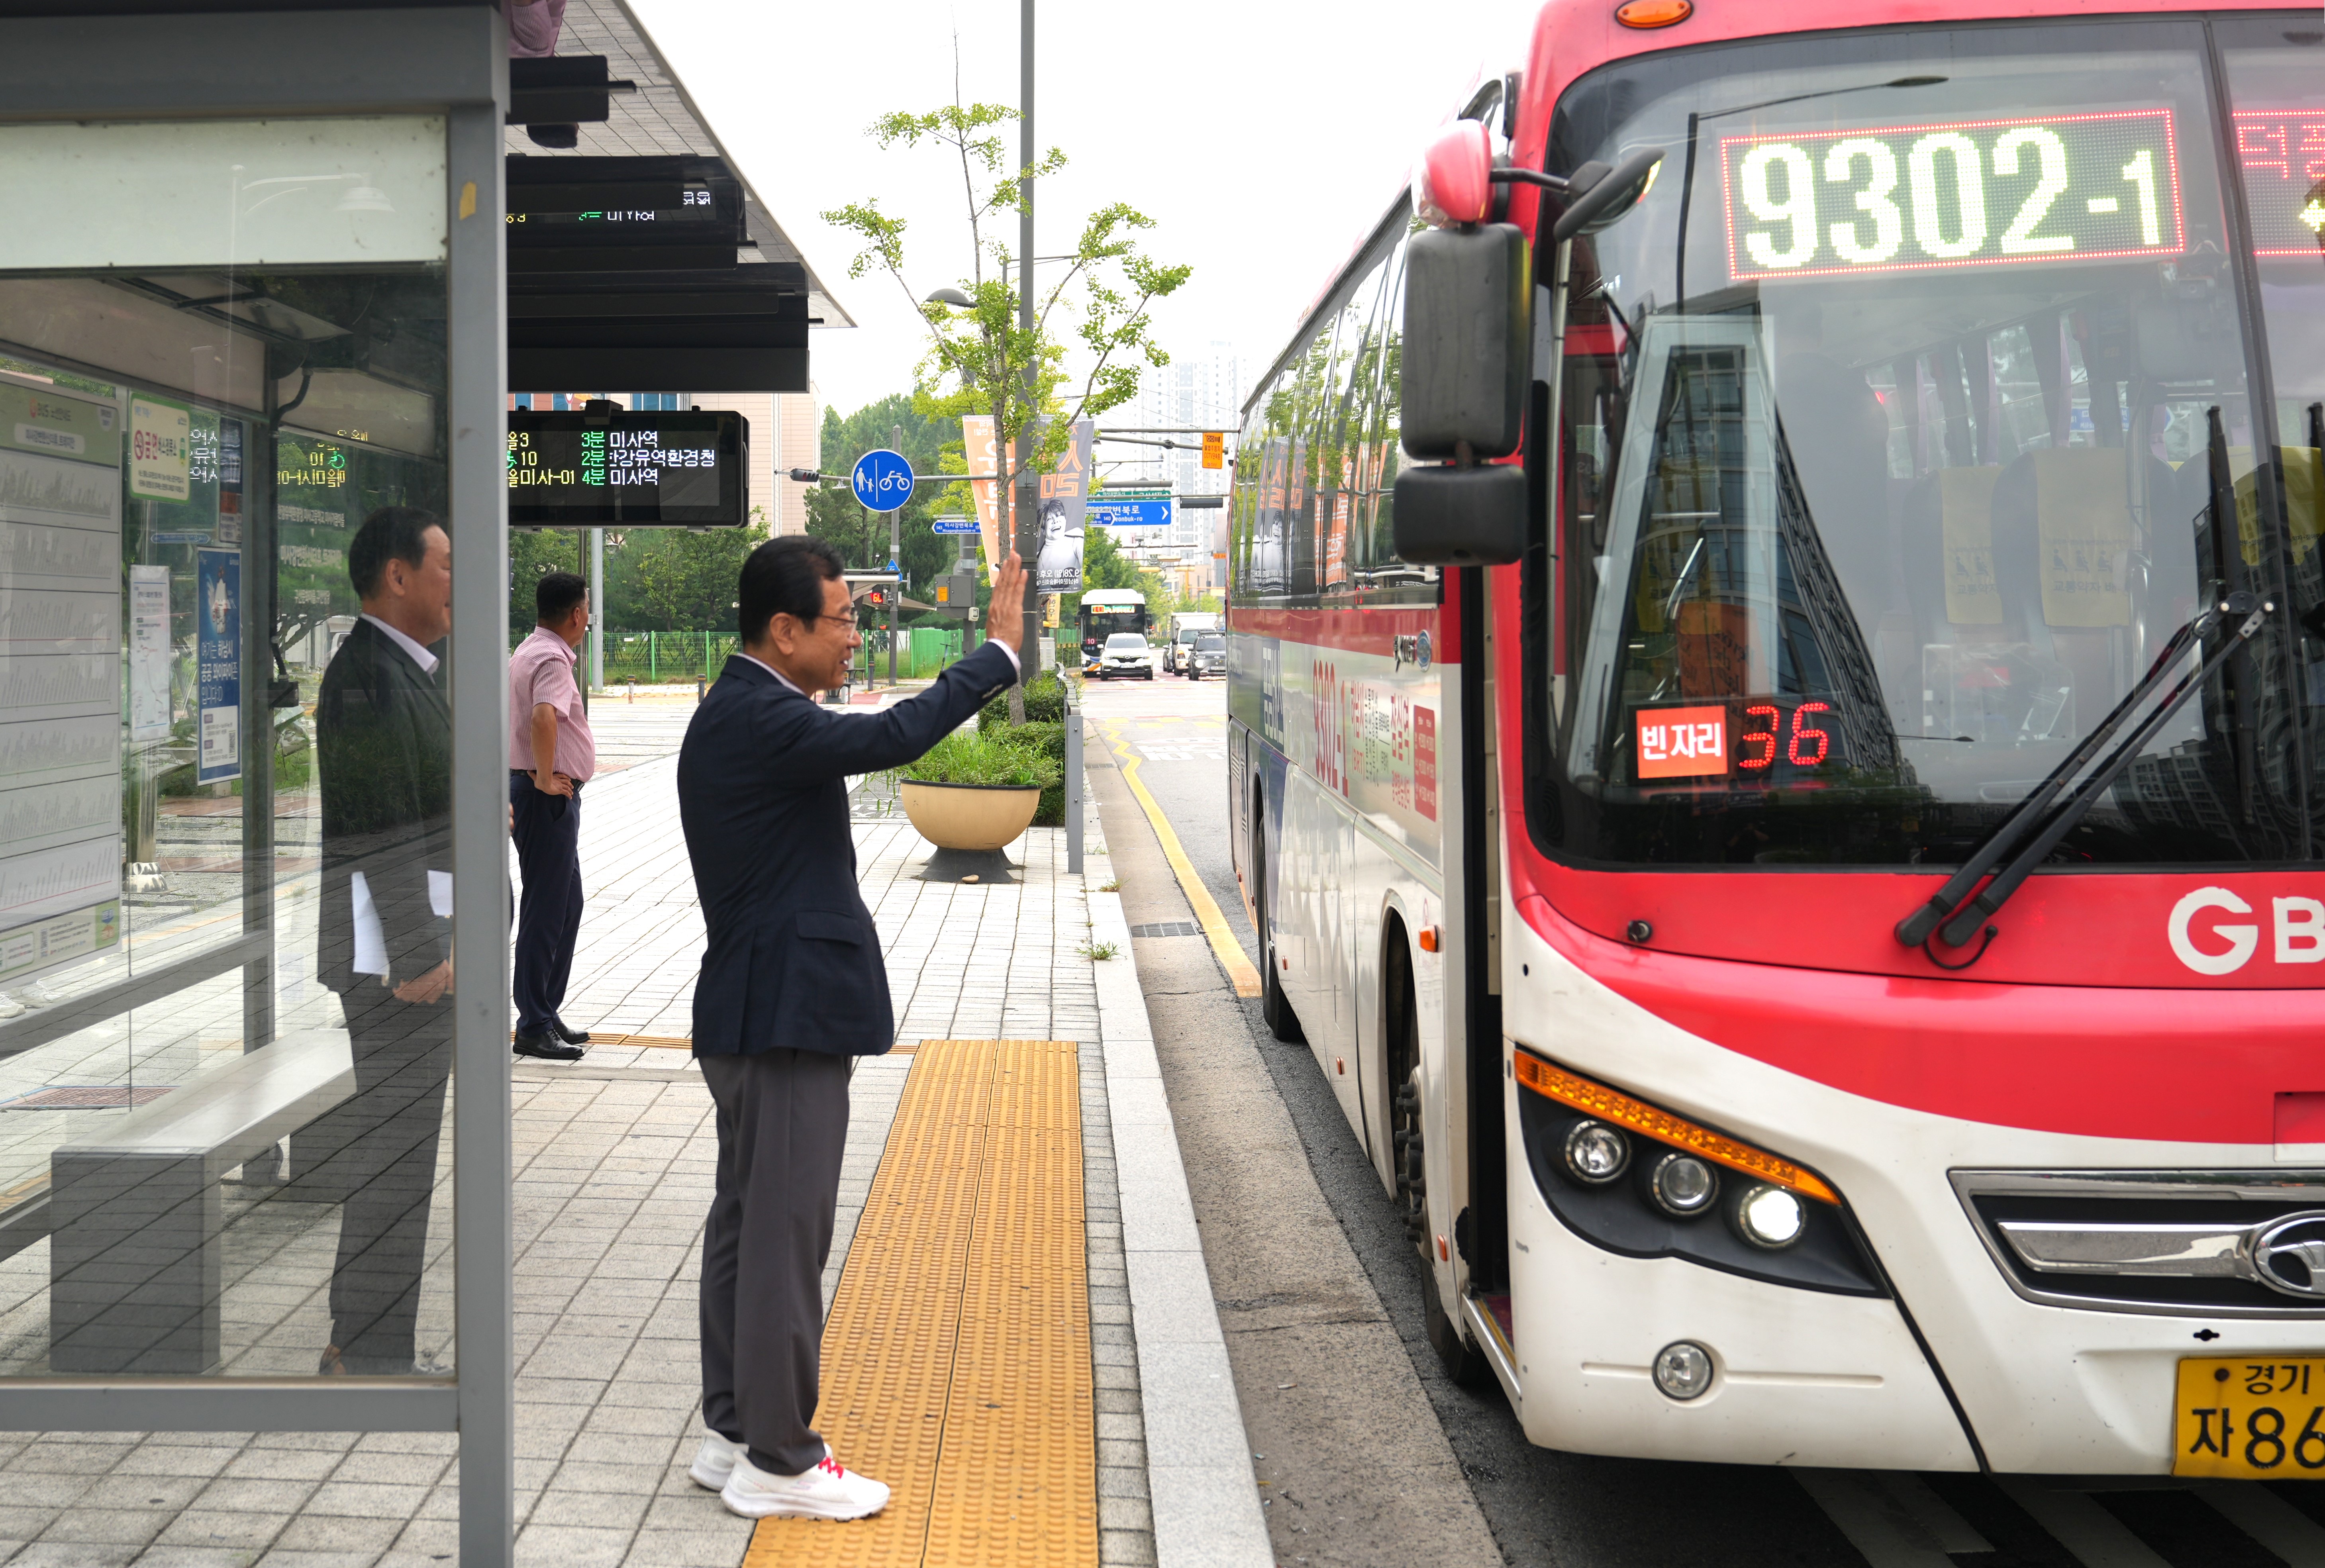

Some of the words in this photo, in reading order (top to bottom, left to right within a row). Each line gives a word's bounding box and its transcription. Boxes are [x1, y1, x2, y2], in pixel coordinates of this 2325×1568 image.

[1741, 125, 2160, 269] 9302-1
[145, 432, 158, 460] 금연
[505, 431, 528, 450] 을3
[582, 431, 605, 447] 3분
[610, 431, 657, 448] 미사역
[521, 451, 537, 465] 10
[582, 450, 605, 466] 2분
[506, 468, 574, 488] 을미사-01
[582, 468, 605, 485] 4분
[611, 468, 657, 485] 미사역
[201, 663, 212, 682] 공공
[1263, 647, 1283, 745] 공공버스
[1351, 680, 1364, 742] 하남시
[1313, 659, 1349, 798] 9302-1
[1391, 693, 1410, 766] 잠실역
[1641, 723, 1722, 760] 빈자리
[1739, 702, 1829, 768] 36
[1351, 745, 1365, 781] (BRT)
[2245, 1365, 2310, 1395] 경기
